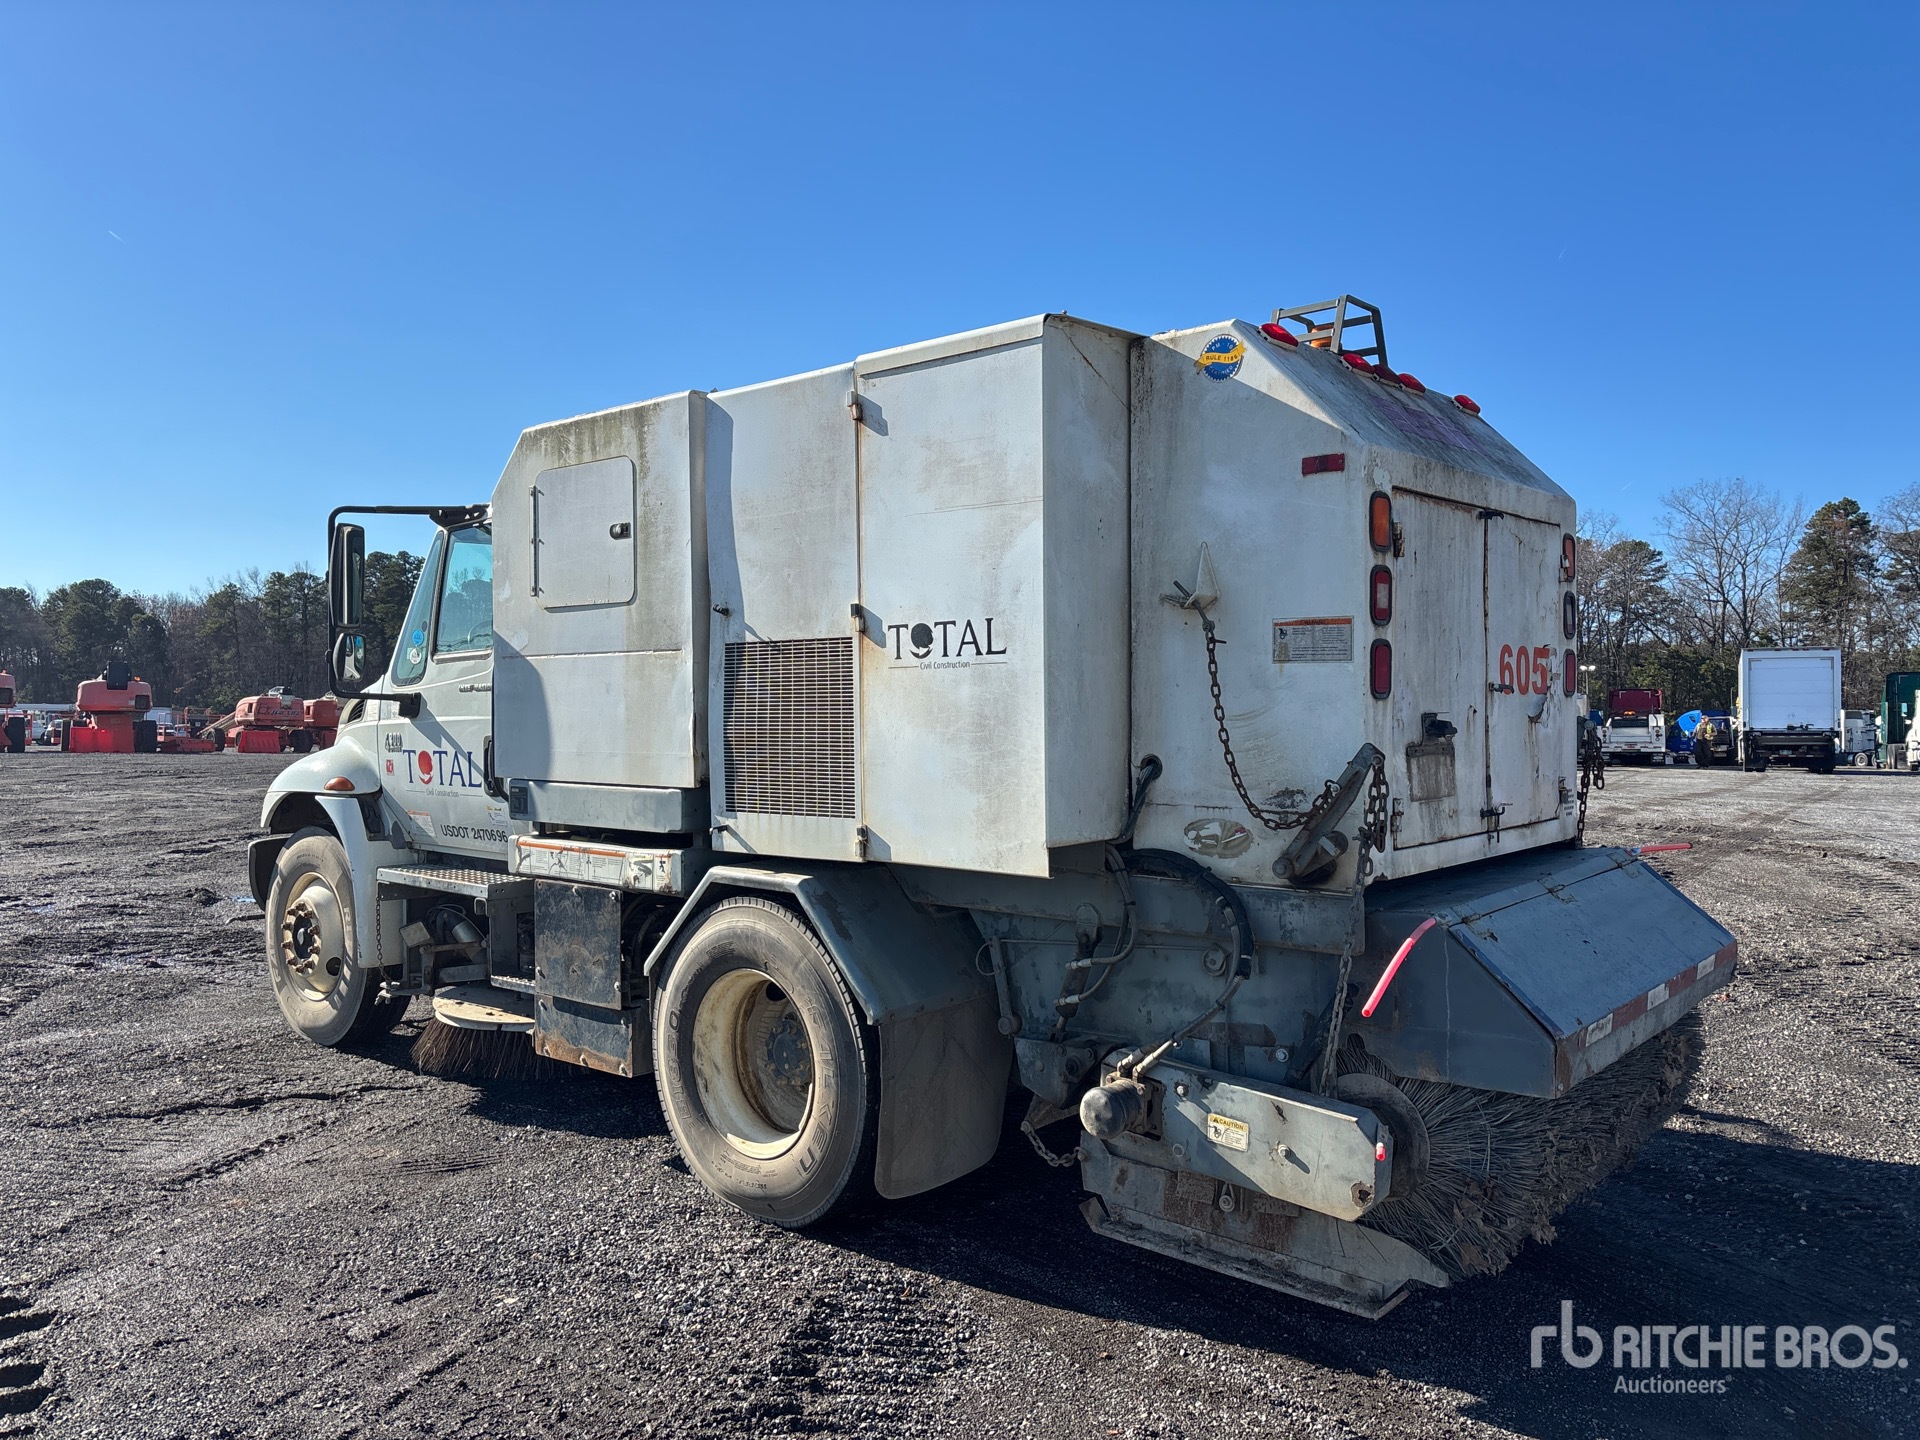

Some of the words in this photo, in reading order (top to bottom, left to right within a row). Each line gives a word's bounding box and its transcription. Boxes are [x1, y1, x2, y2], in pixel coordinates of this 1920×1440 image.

[887, 617, 1007, 660] TOTAL
[920, 662, 932, 670] Civil
[933, 661, 970, 669] Construction
[1500, 644, 1550, 695] 605
[403, 750, 482, 788] TOTAL
[426, 789, 434, 797] Civil
[435, 789, 460, 798] Construction
[440, 825, 470, 838] USDOT
[471, 829, 508, 842] 2470696
[1220, 1119, 1244, 1131] CAUTION
